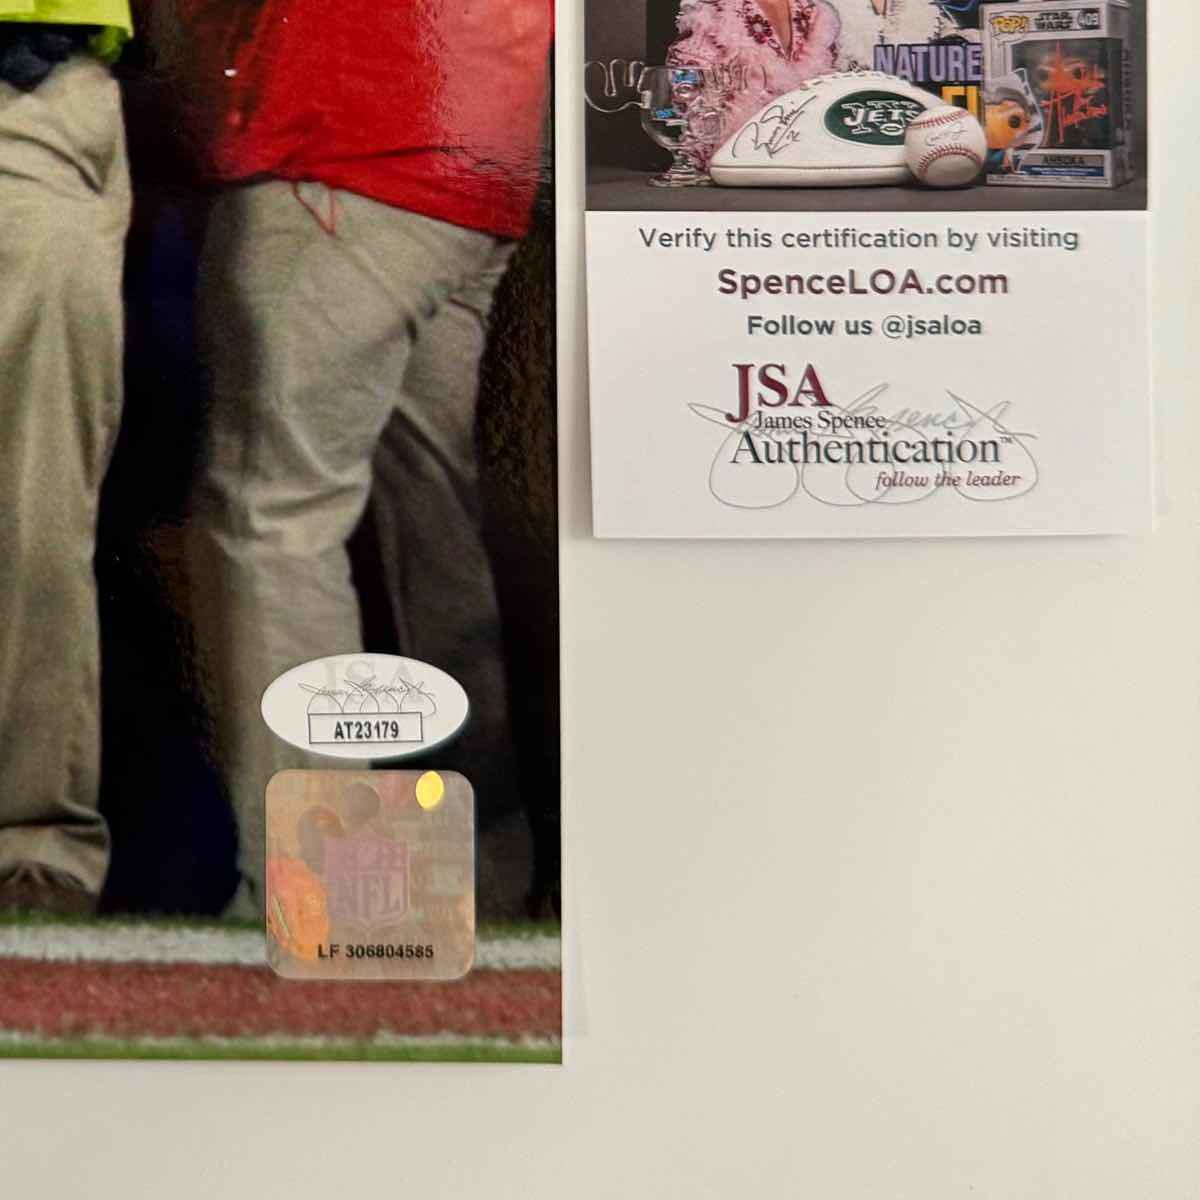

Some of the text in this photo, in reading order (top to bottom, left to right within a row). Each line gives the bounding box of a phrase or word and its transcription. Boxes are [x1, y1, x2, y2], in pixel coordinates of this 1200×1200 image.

[873, 45, 982, 81] NATURE
[638, 227, 1079, 252] Verify this certification by visiting
[717, 267, 1010, 300] SpenceLOA.com
[747, 314, 983, 339] Follow us @jsaloa
[725, 362, 832, 424] JSA
[753, 410, 886, 432] James Spence
[875, 470, 1022, 491] follow the leader
[333, 720, 400, 740] AT23179
[317, 943, 435, 959] LF 306804585
